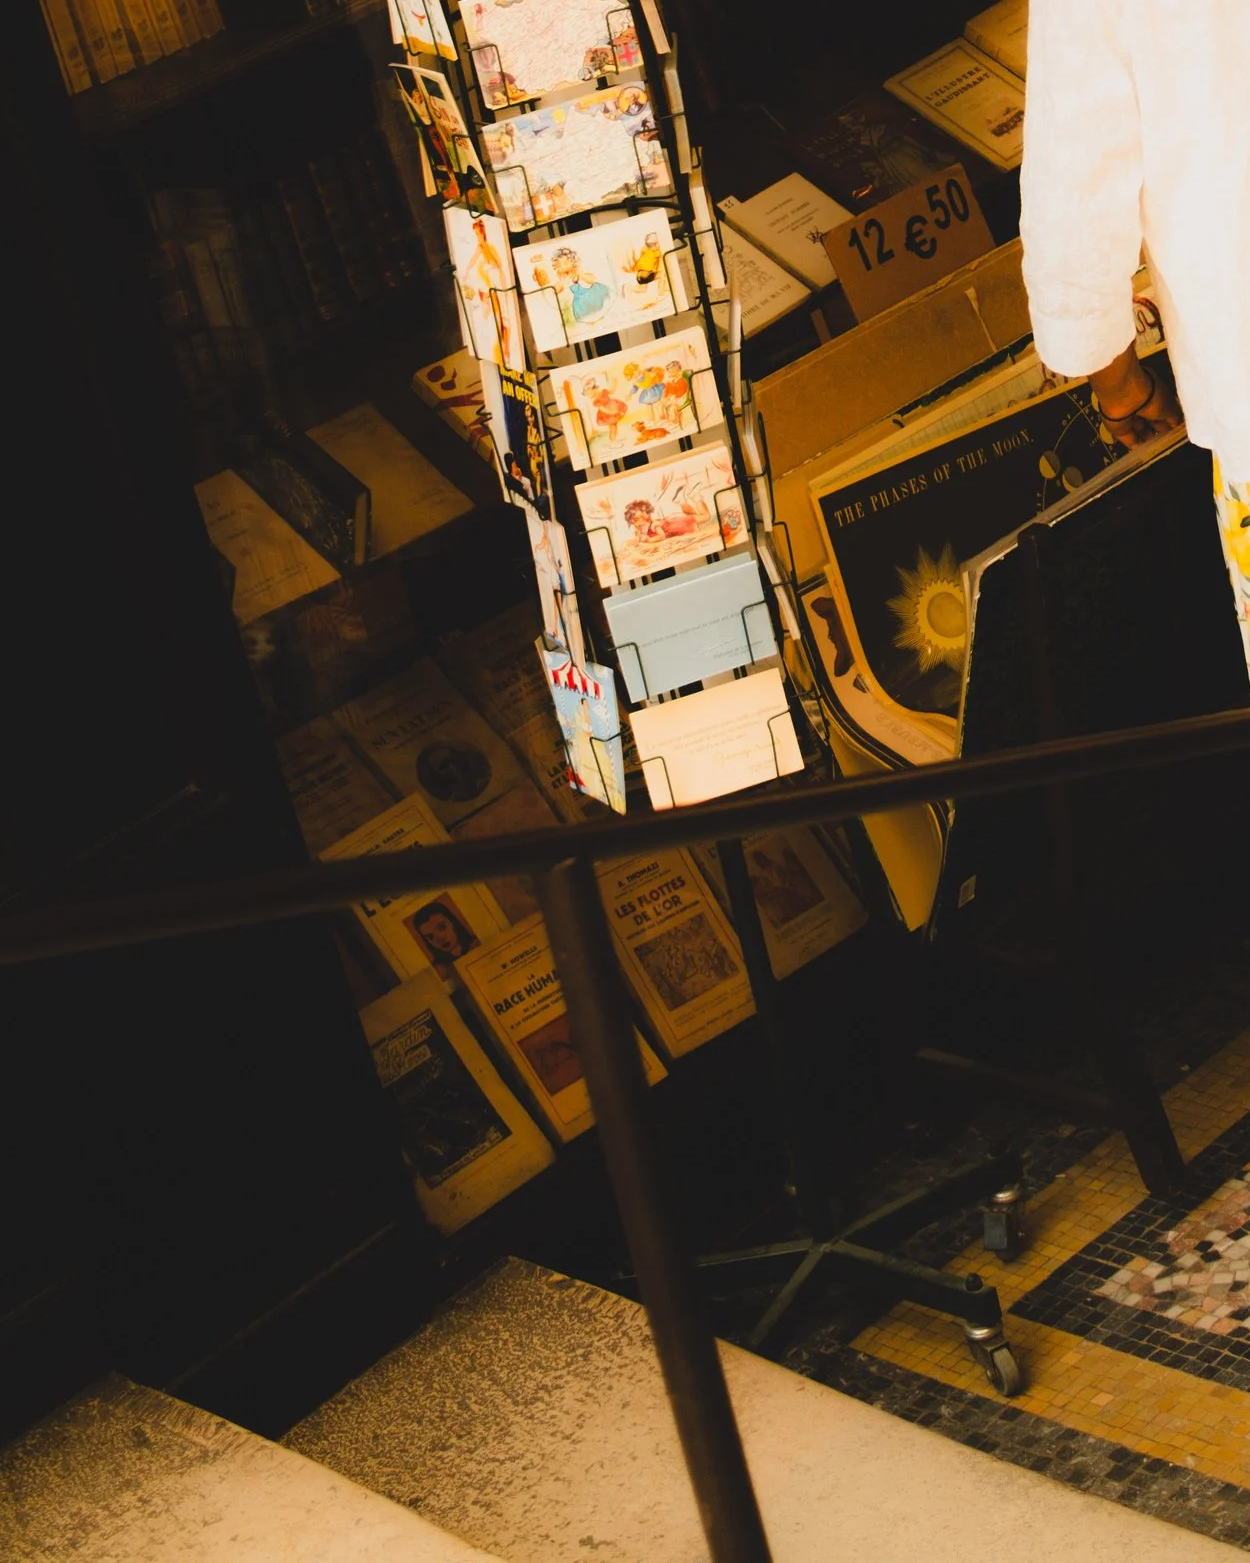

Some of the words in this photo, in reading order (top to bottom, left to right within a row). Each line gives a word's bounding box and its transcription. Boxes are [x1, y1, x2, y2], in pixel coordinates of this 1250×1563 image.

[925, 64, 982, 102] L'ILLUSTRE
[848, 218, 895, 271] 12
[834, 501, 866, 529] THE
[870, 474, 929, 514] PHASES
[933, 461, 953, 484] OF
[957, 444, 989, 474] THE
[625, 861, 659, 882] THOMAZI
[613, 901, 636, 919] LES
[636, 876, 686, 906] FLOTTES
[632, 910, 650, 926] DE
[651, 894, 682, 916] L'OR
[492, 989, 526, 1015] RACE
